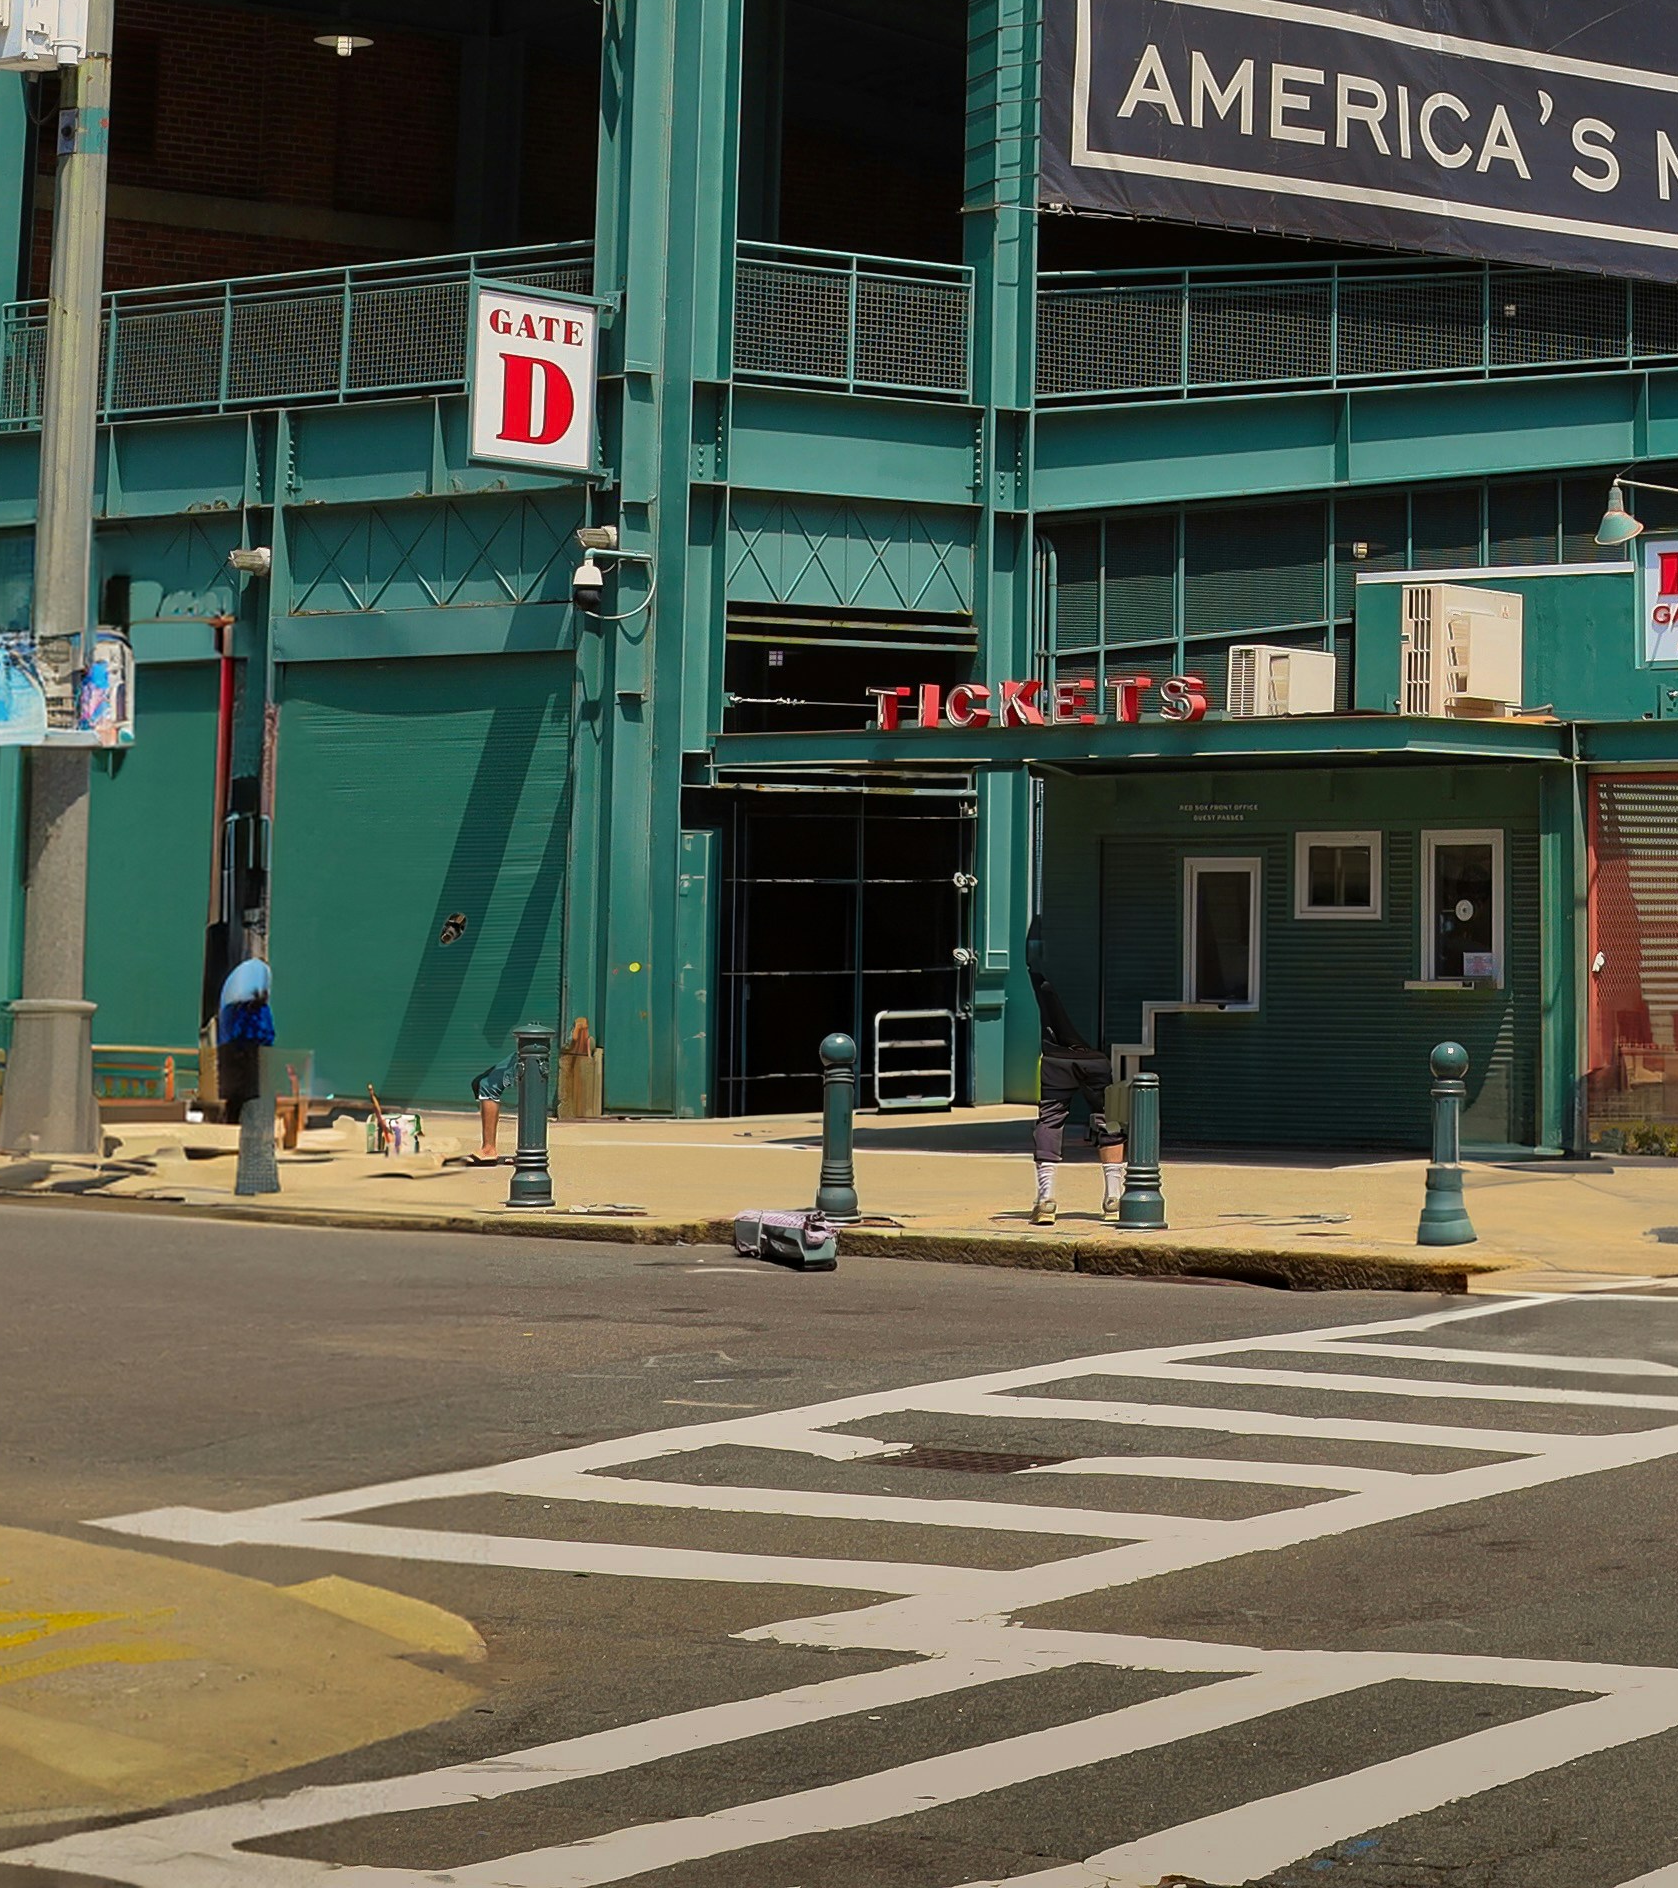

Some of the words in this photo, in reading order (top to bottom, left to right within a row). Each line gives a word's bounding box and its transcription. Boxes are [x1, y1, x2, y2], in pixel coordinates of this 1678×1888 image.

[1117, 44, 1621, 193] AMERICA'S
[489, 308, 584, 347] GATE
[496, 352, 575, 445] D
[866, 675, 1207, 731] TICKETS
